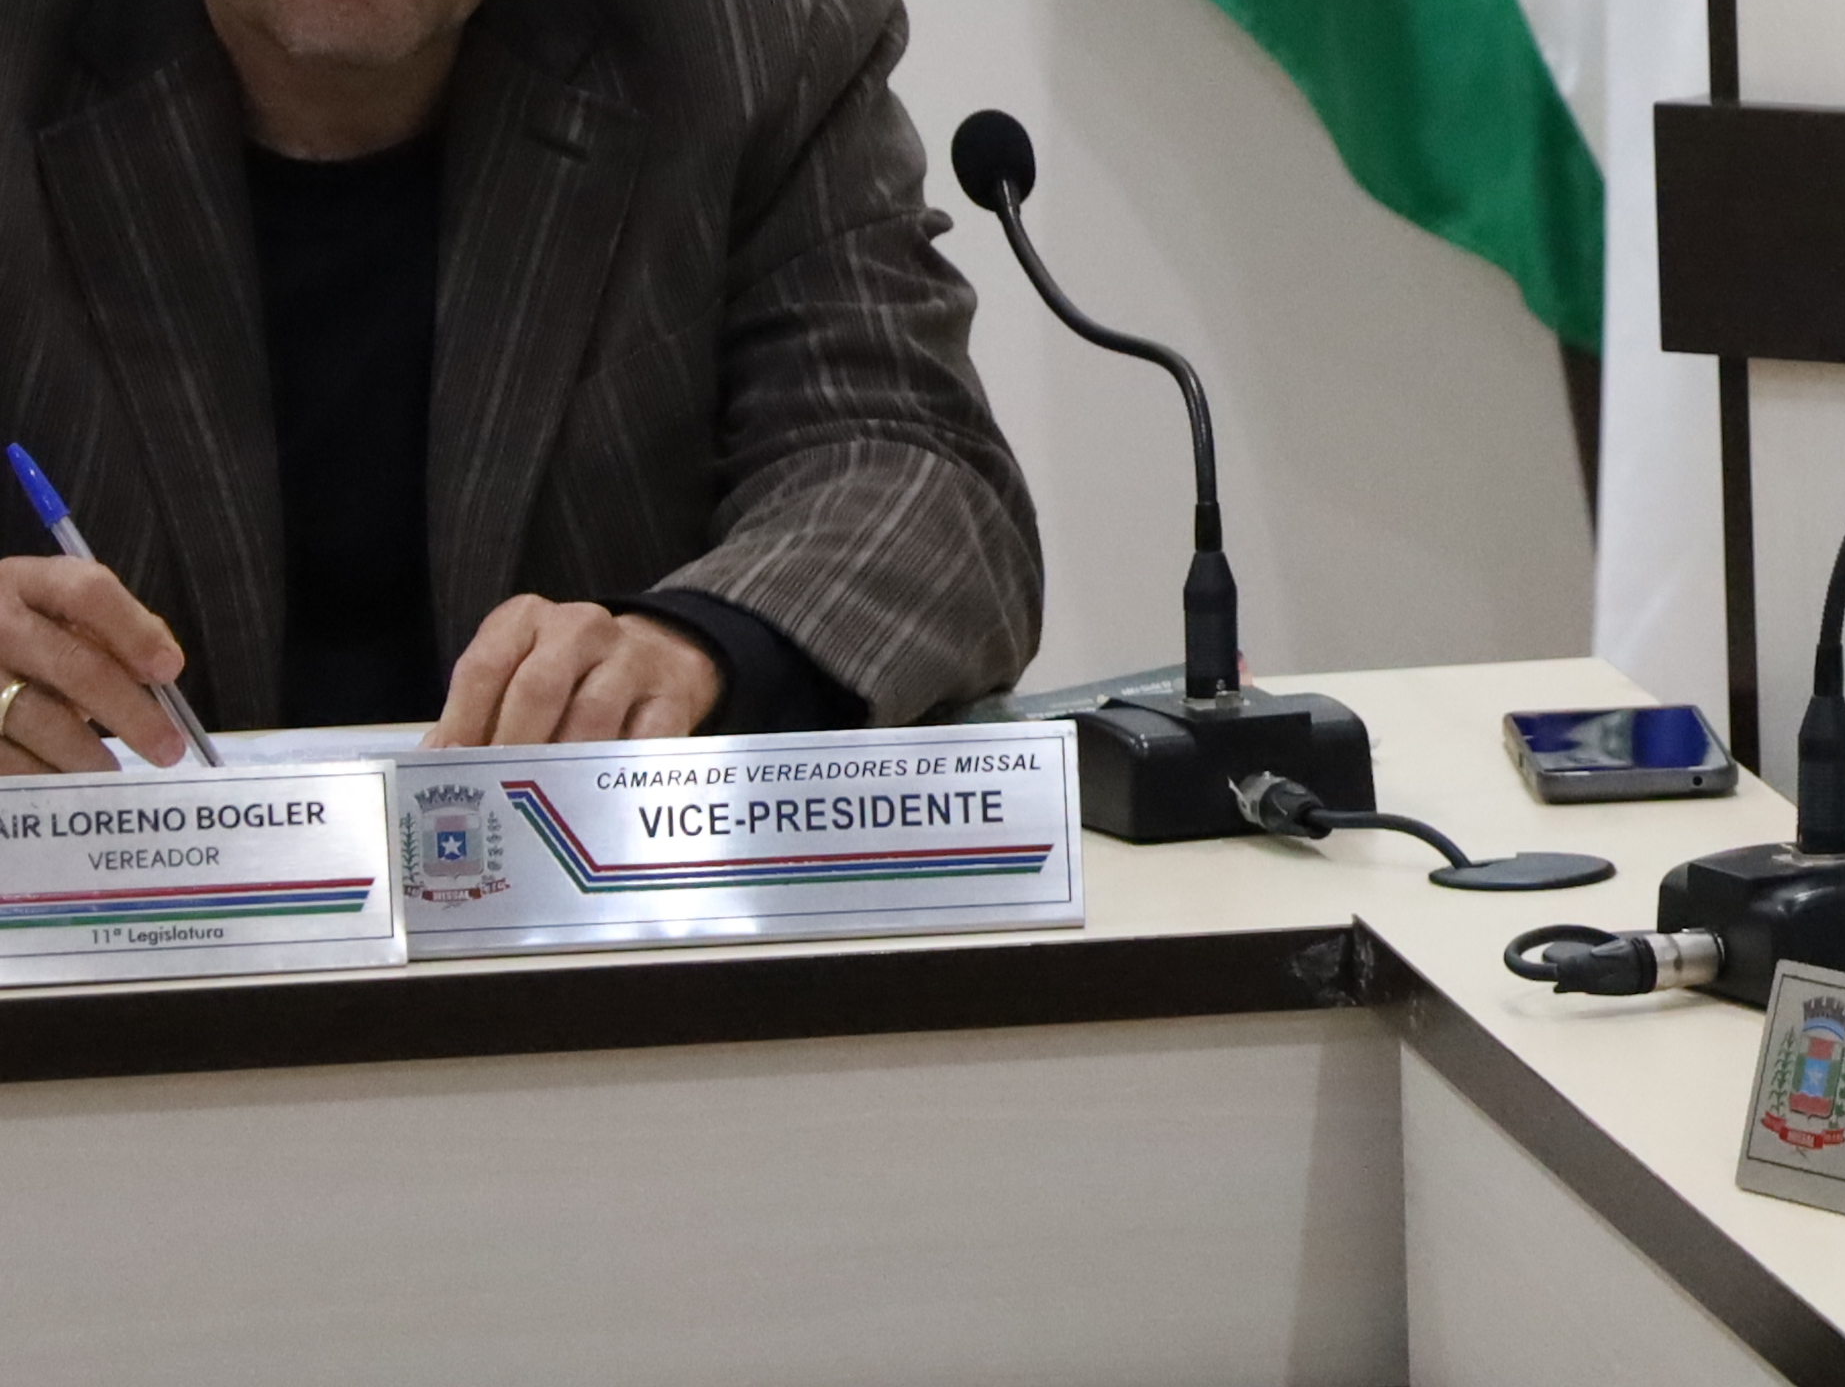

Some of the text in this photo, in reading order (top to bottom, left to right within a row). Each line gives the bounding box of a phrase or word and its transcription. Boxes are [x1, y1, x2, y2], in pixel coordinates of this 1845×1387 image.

[597, 753, 1042, 789] CÂMARA DE VEREADORES DE MISSAL
[51, 806, 186, 838] LORENO
[196, 801, 326, 830] BOGLER
[639, 789, 1005, 838] VICE-PRESIDENTE
[88, 847, 219, 870] VEREADOR
[128, 926, 224, 946] Legislatura
